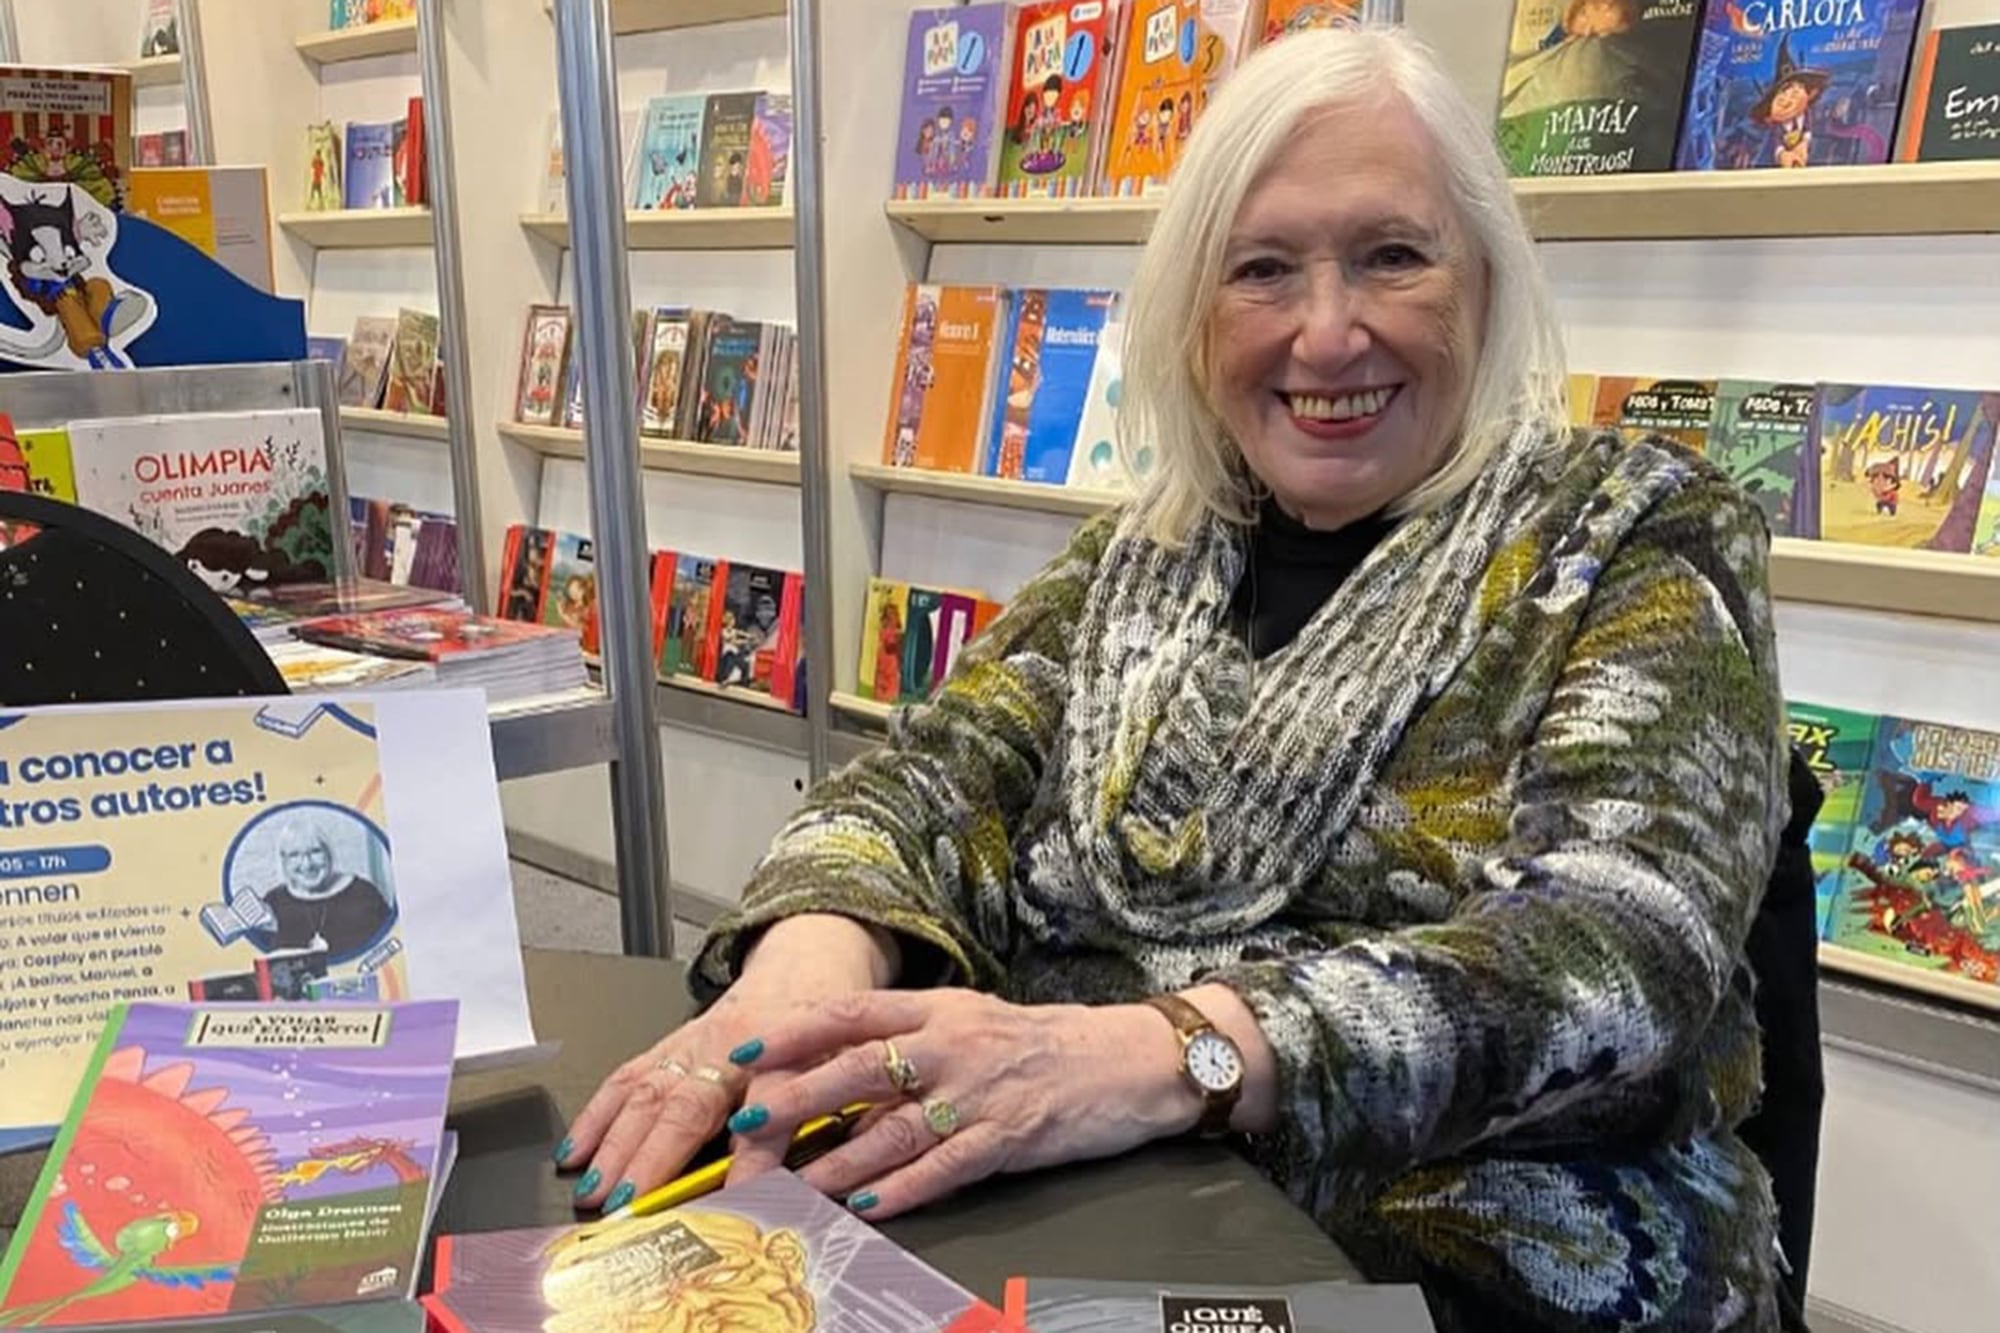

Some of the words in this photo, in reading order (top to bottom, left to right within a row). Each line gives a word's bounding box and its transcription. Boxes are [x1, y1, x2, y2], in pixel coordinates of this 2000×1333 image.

[1540, 98, 1639, 150] ¡MAMÁ!
[1842, 401, 1958, 452] ¡ACHÍS!
[134, 447, 272, 483] OLIMPIA
[139, 485, 202, 504] cuenta
[19, 742, 196, 784] conocer
[204, 739, 234, 765] a
[91, 771, 267, 818] autores!
[265, 1206, 313, 1220] Olga
[1182, 1304, 1264, 1323] ¡QUÉ
